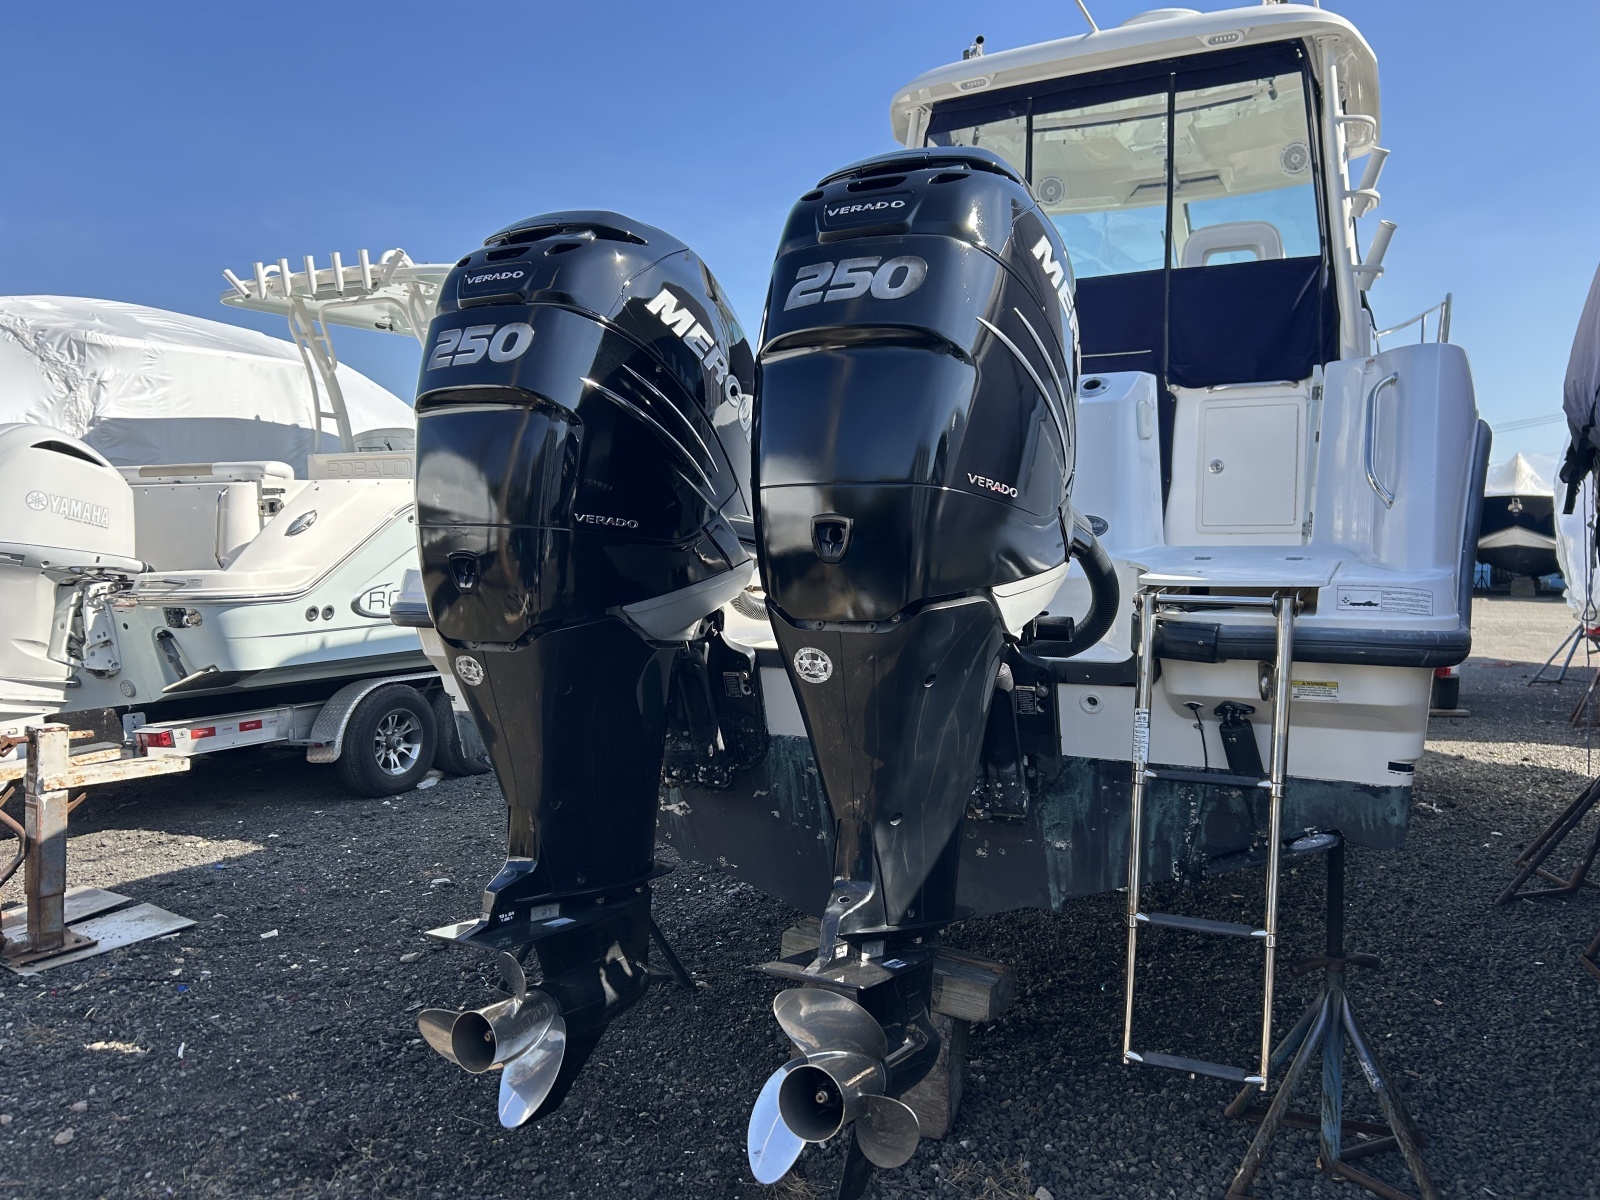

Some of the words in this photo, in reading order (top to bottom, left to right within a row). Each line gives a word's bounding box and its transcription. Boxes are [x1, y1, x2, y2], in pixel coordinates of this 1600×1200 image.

[828, 200, 905, 217] VERADO
[467, 271, 524, 284] VERADO
[784, 256, 928, 312] 250
[427, 322, 535, 371] 250
[327, 460, 409, 478] ROBALO
[967, 472, 1019, 498] VERADO
[49, 494, 109, 525] YAMAHA
[574, 513, 639, 528] VERADO
